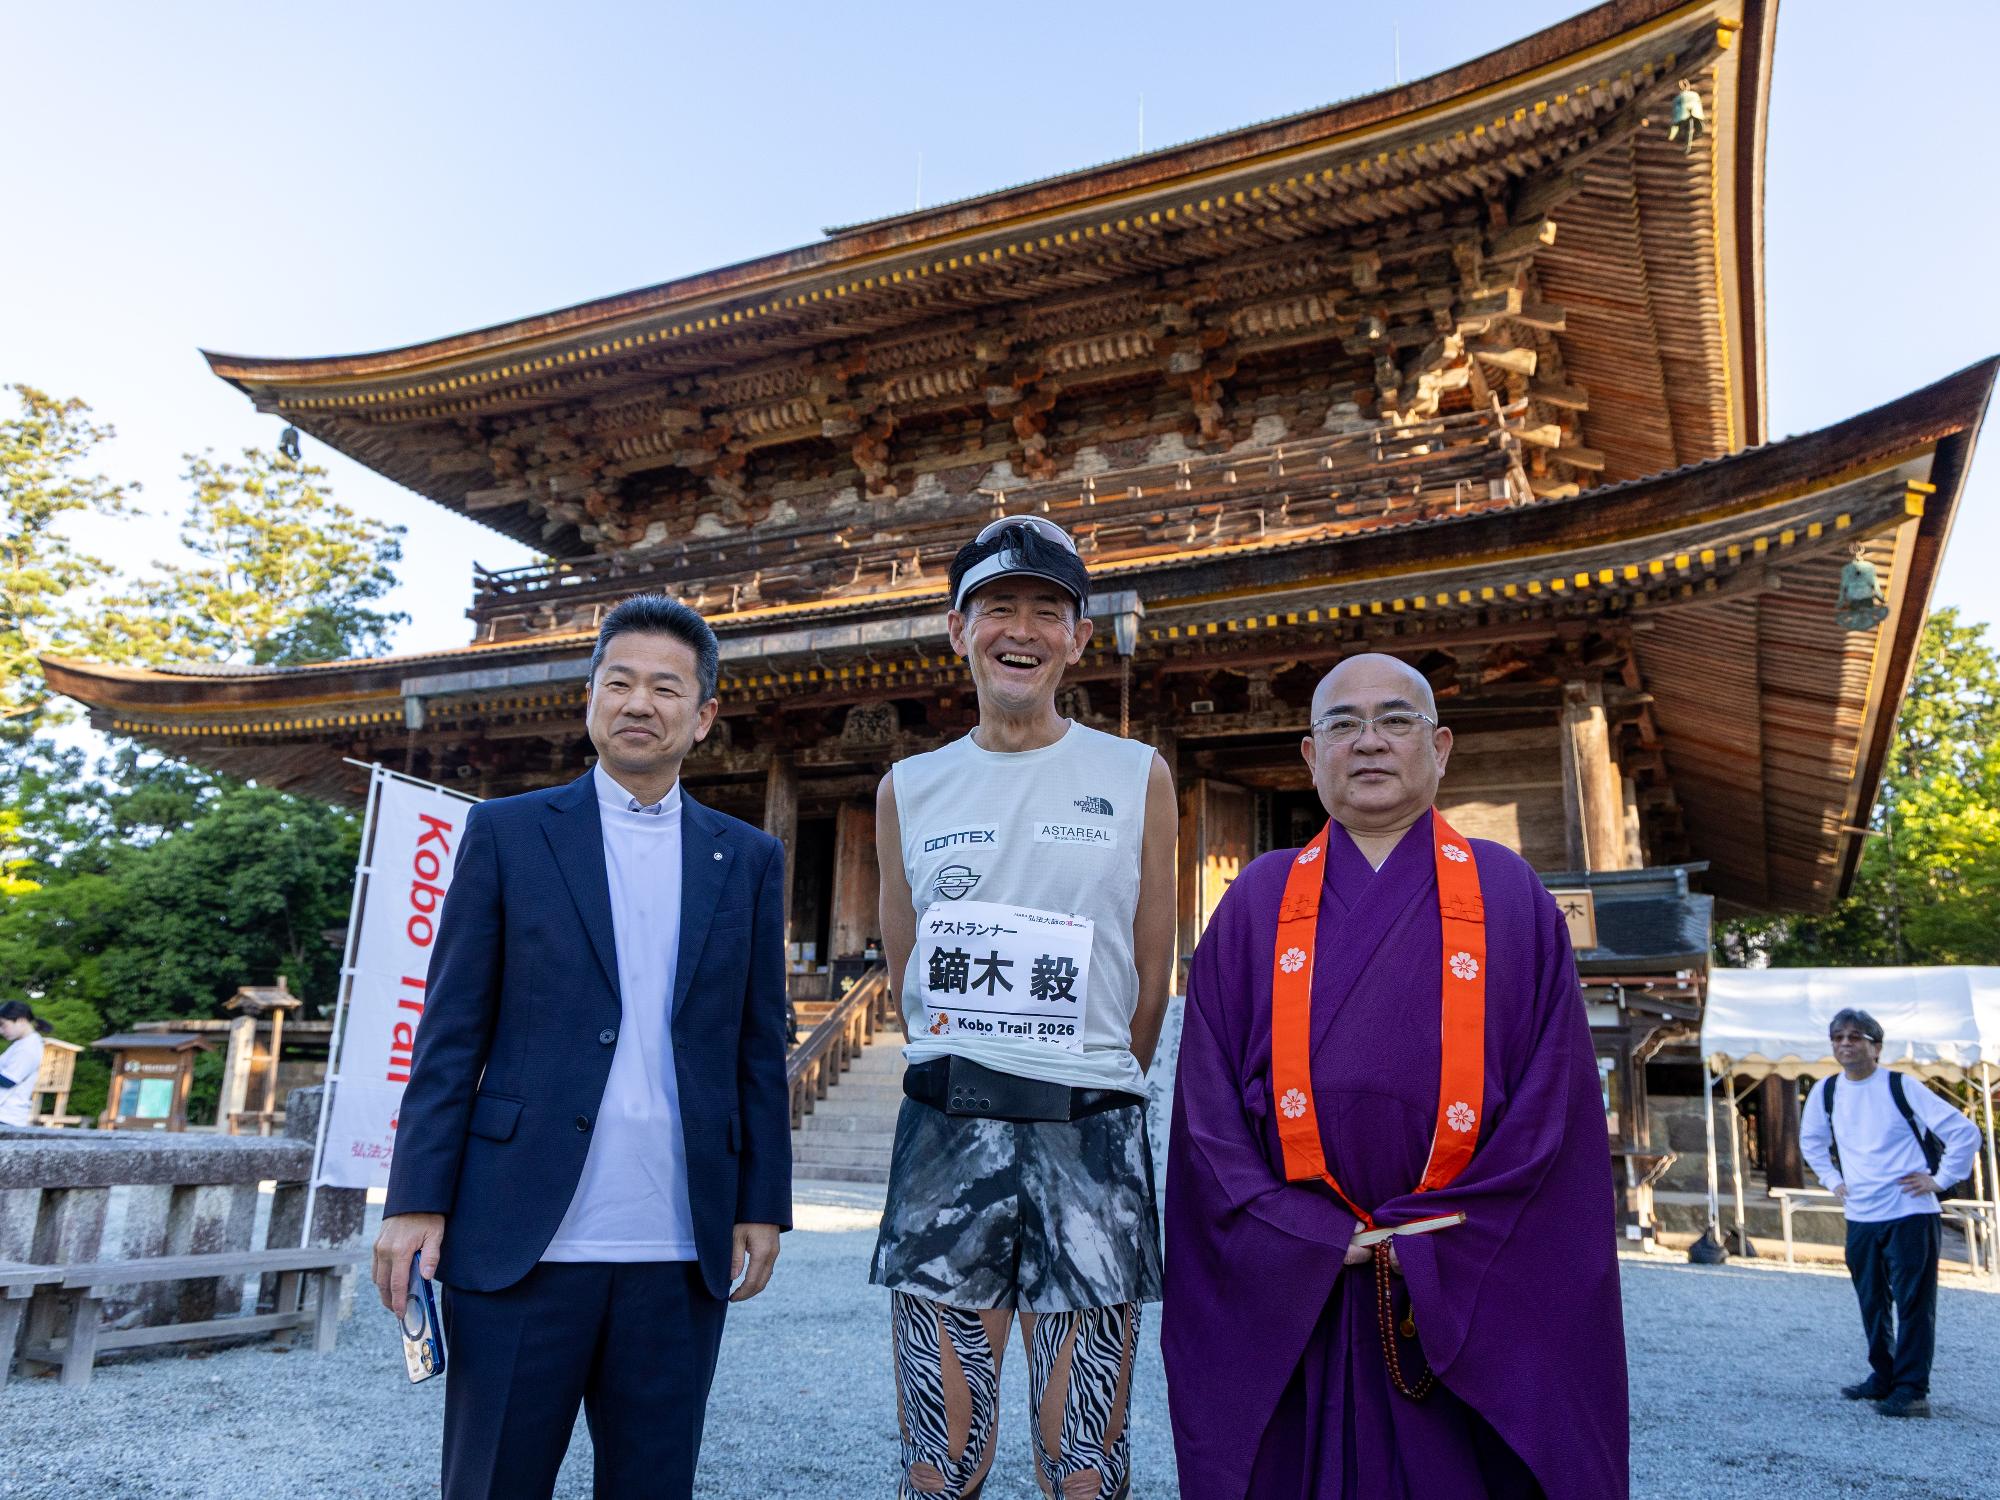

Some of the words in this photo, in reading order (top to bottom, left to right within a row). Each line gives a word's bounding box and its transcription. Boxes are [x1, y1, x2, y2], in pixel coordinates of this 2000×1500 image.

[1073, 800, 1100, 809] NORTH
[1085, 795, 1100, 803] THE
[1081, 806, 1100, 815] FACE
[1041, 825, 1111, 841] ASTAREAL
[405, 812, 453, 948] Kobo
[929, 919, 1018, 937] ゲストランナー
[928, 945, 1014, 996] 鏑木
[1029, 953, 1080, 1004] 毅
[957, 1017, 993, 1032] Kobo
[997, 1020, 1032, 1035] Trail
[1037, 1022, 1075, 1036] 2026
